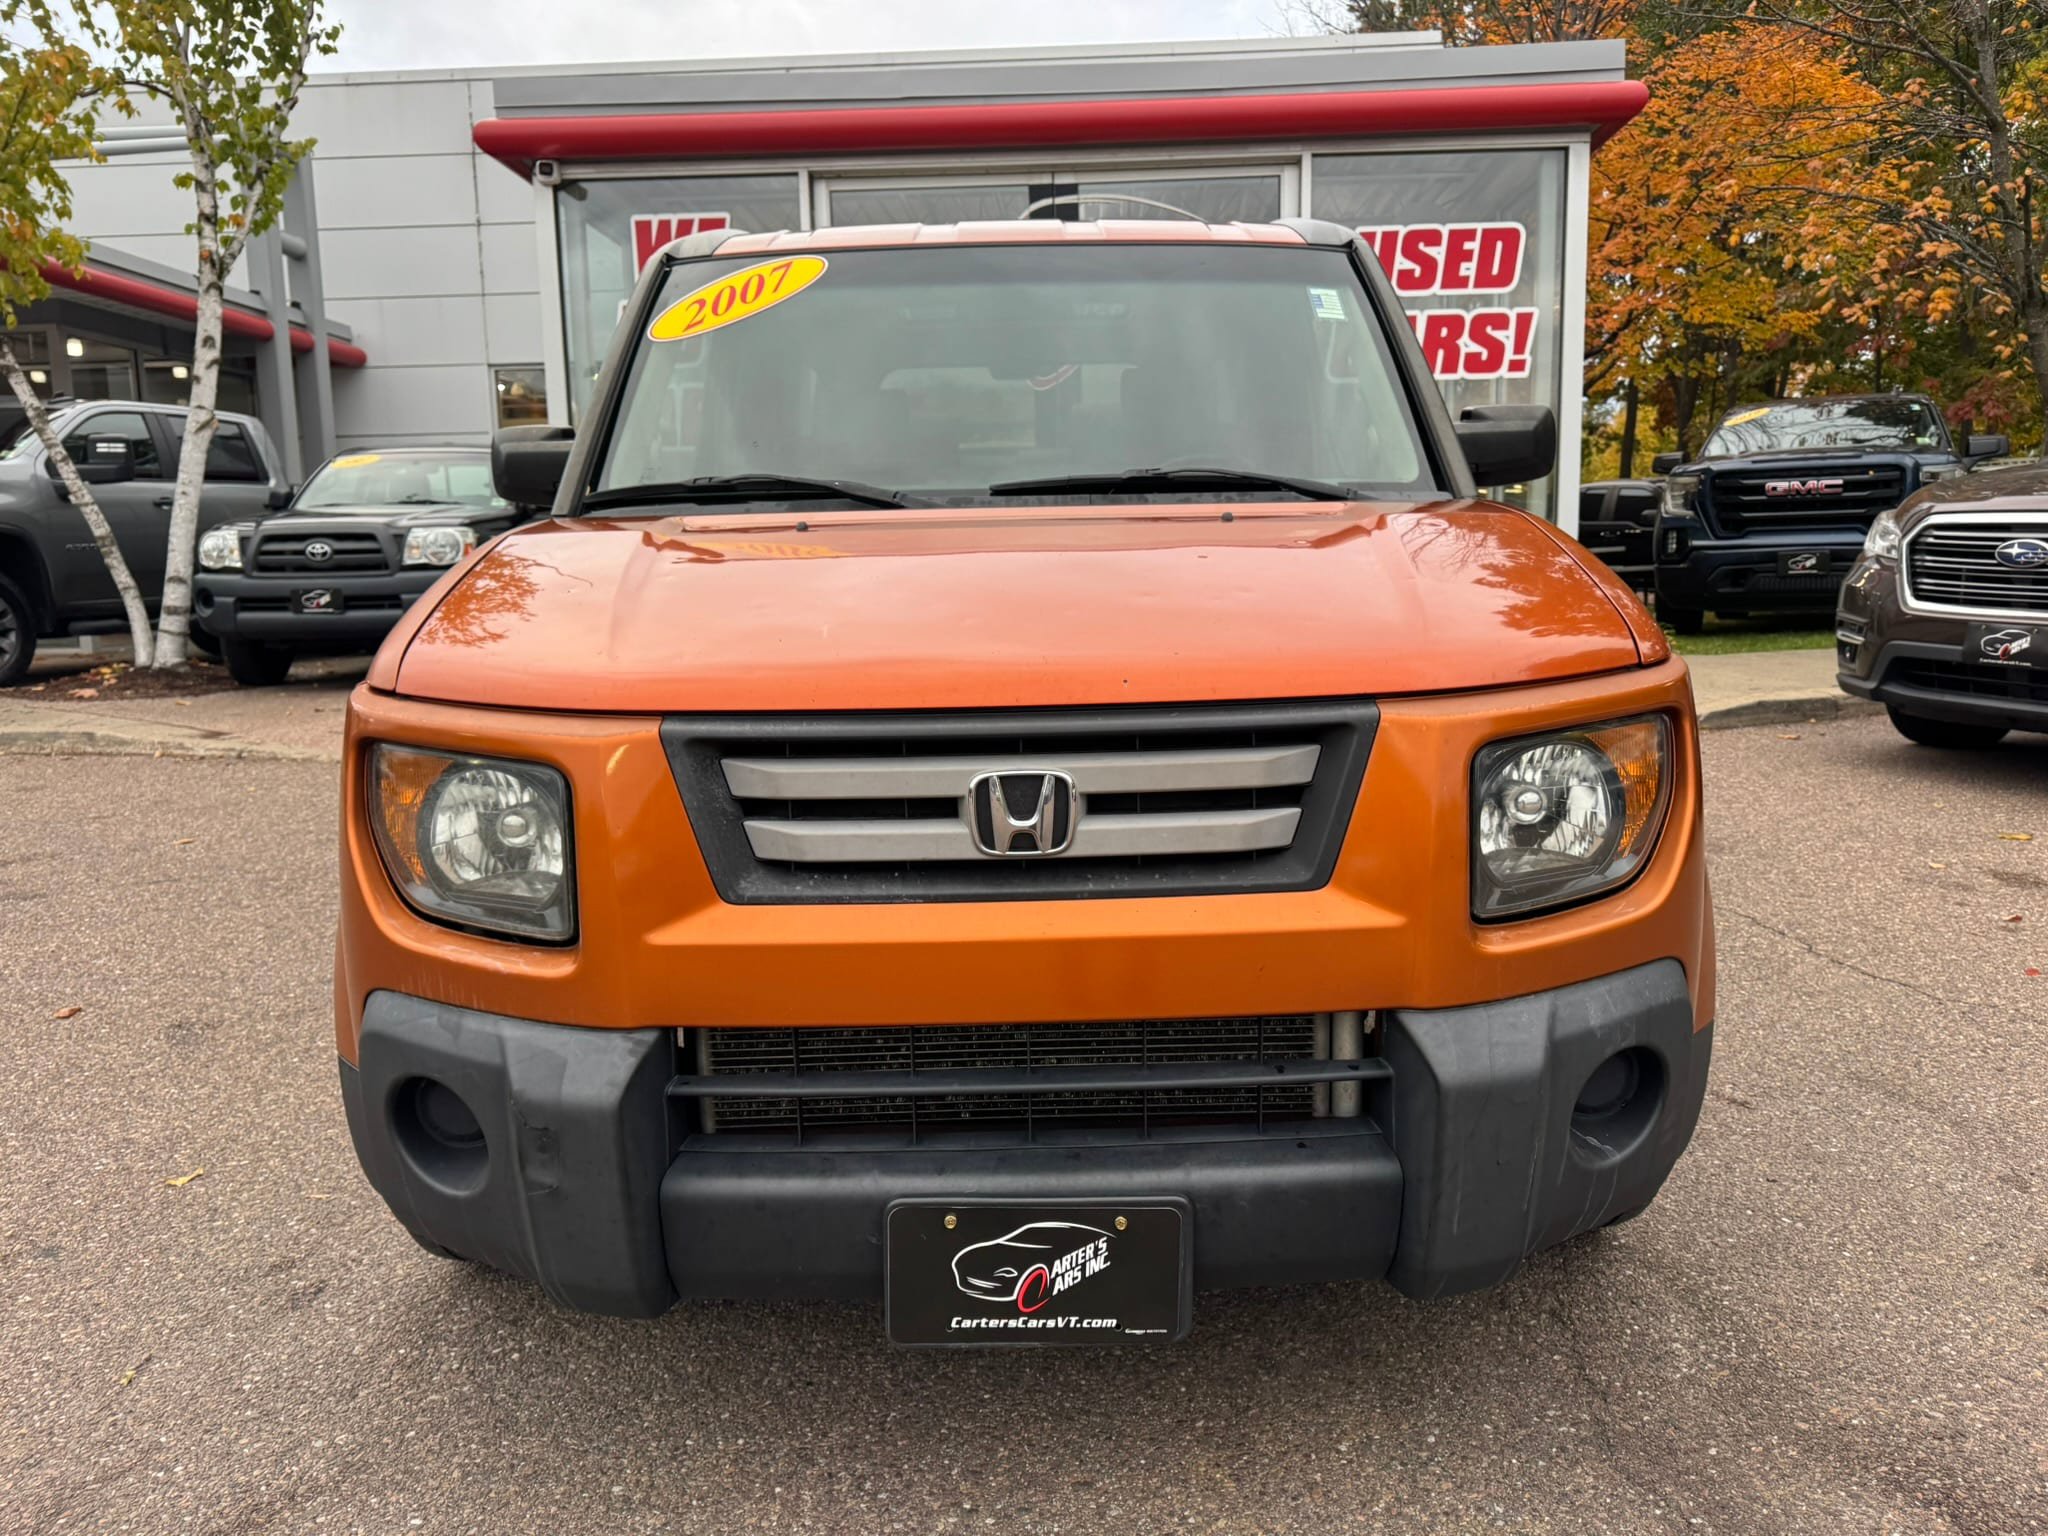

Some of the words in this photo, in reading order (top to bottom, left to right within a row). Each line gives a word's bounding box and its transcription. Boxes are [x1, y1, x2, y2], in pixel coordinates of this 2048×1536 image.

[1358, 226, 1524, 293] USED
[683, 261, 793, 332] 2007
[1406, 309, 1537, 376] RS!
[1765, 479, 1844, 496] GMC
[1086, 1252, 1111, 1278] INC
[951, 1316, 1117, 1329] CartersCarsVT.com
